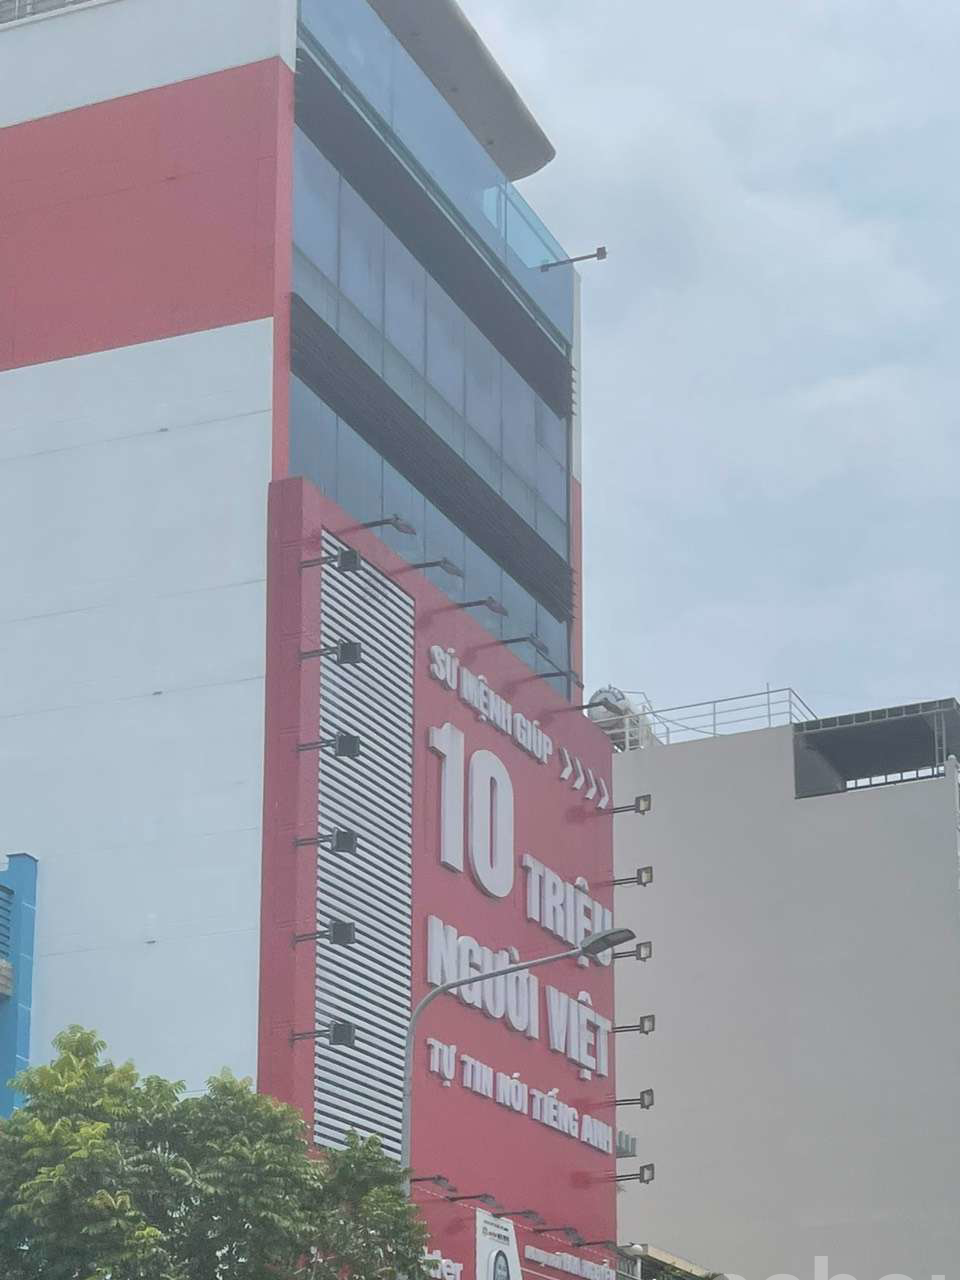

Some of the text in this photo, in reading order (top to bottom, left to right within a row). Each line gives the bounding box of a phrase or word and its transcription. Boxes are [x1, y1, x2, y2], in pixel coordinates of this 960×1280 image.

[428, 722, 515, 898] 10
[522, 853, 613, 967] TRIỆU
[546, 985, 612, 1080] VIỆT
[427, 1037, 613, 1154] TỰ TIN NÓI TIẾNG ANH
